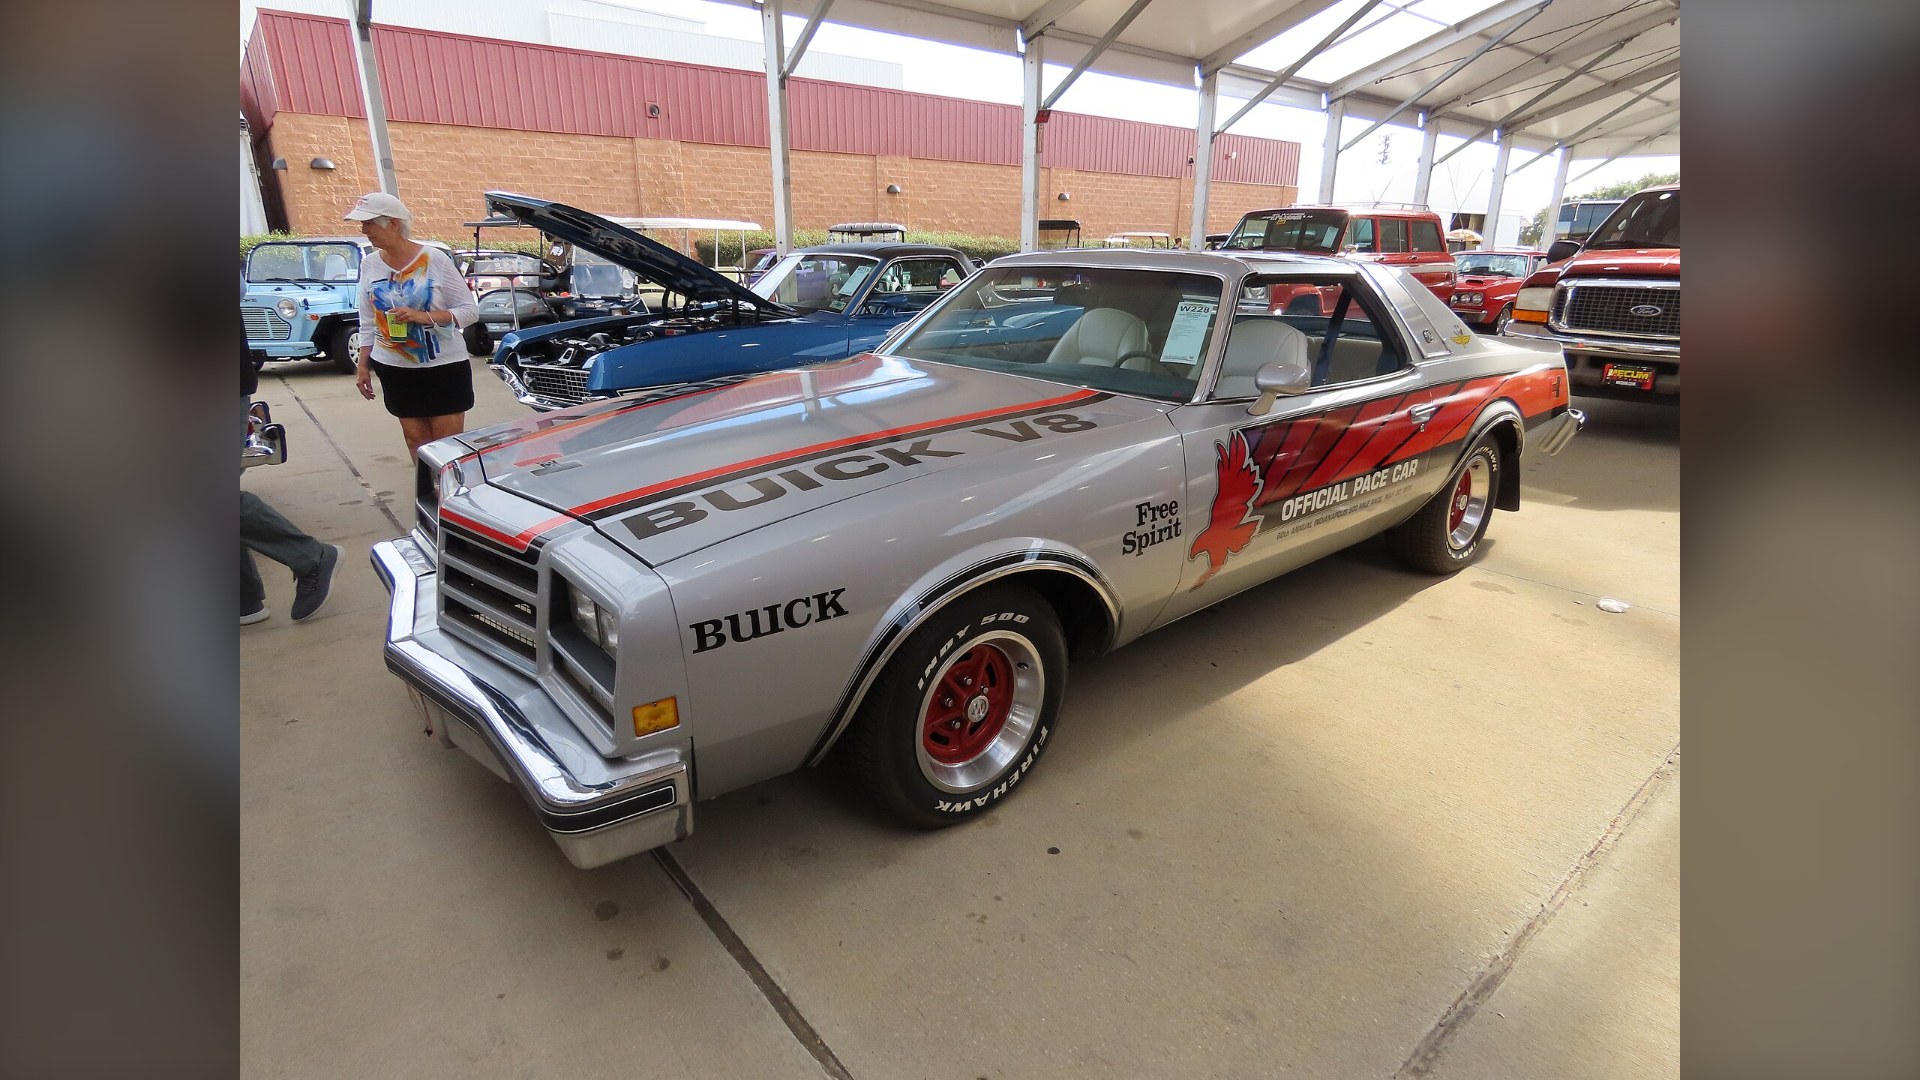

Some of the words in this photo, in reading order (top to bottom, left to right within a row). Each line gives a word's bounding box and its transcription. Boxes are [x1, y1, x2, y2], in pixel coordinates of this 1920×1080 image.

[1180, 305, 1210, 314] W228
[1607, 369, 1649, 380] MECUM
[620, 438, 965, 541] BUICK
[972, 413, 1098, 443] V8
[1281, 481, 1349, 522] OFFICIAL
[1352, 471, 1389, 498] PACE
[1391, 458, 1419, 484] CAR
[1122, 520, 1182, 556] Spirit
[1136, 498, 1178, 527] Free
[689, 587, 849, 654] BUICK
[917, 624, 971, 692] INDY
[980, 611, 1031, 626] 500
[934, 725, 1050, 813] FIREHAWK
